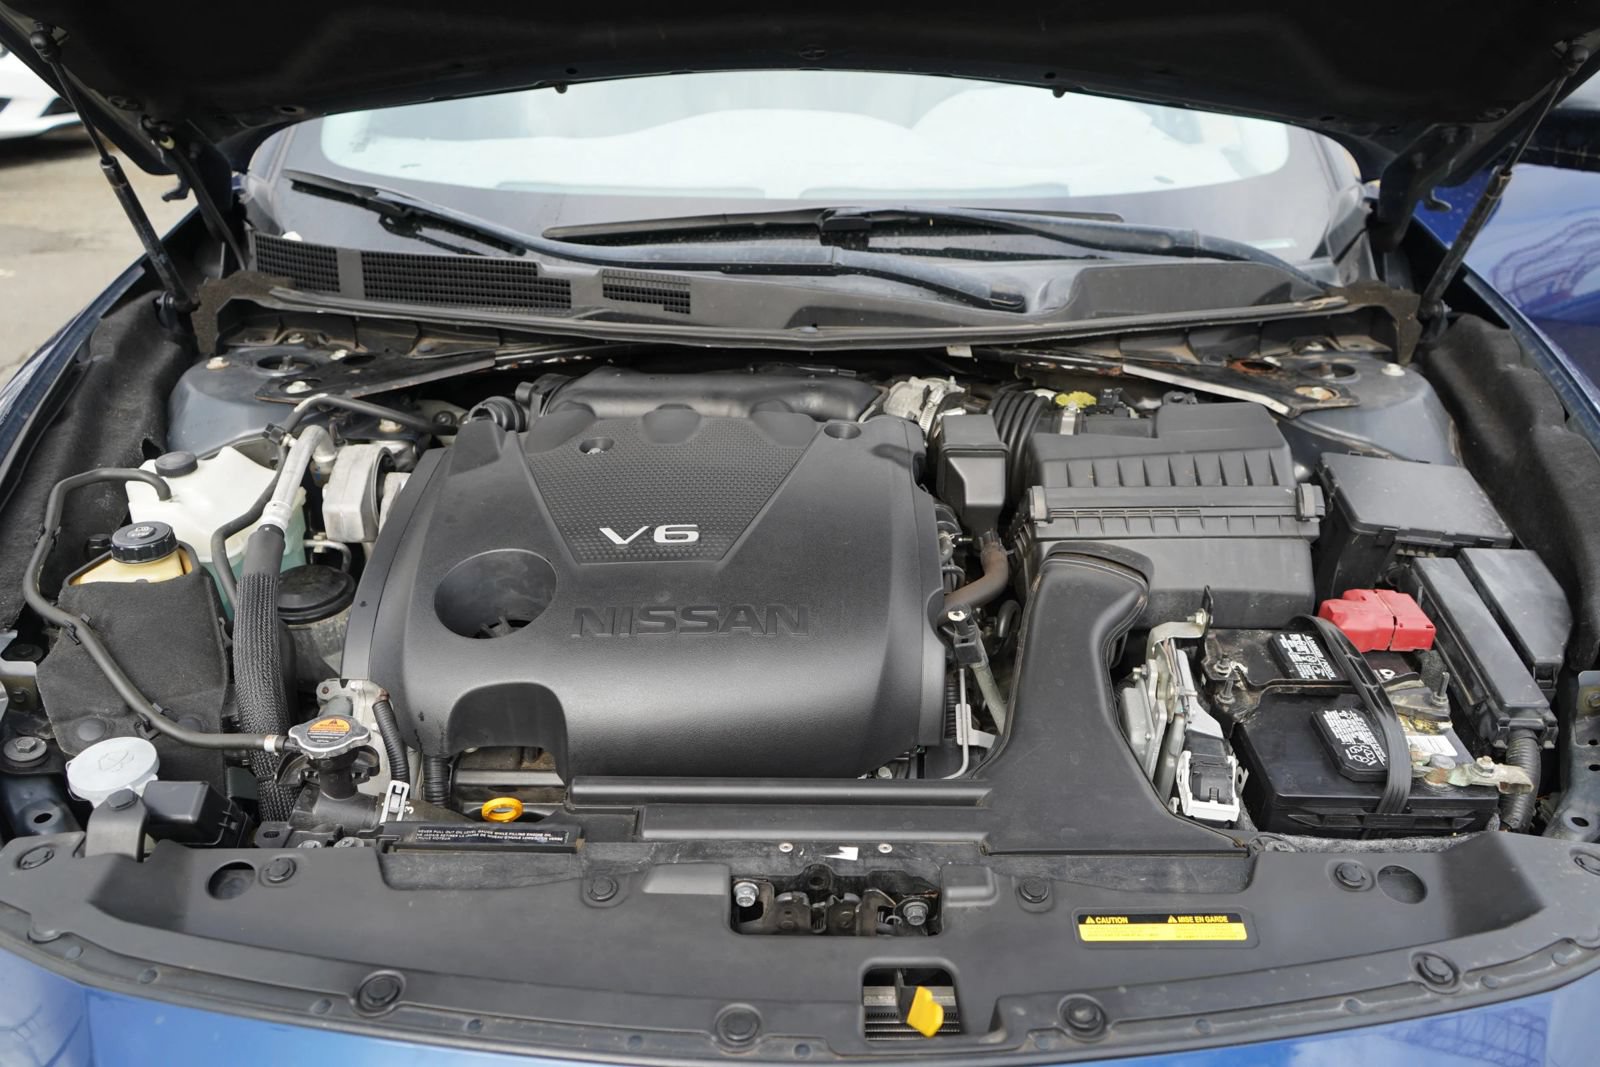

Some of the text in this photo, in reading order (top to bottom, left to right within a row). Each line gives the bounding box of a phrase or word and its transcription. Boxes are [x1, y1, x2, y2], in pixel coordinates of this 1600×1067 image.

[599, 524, 700, 545] V6
[571, 603, 809, 638] NISSAN
[1095, 916, 1129, 924] CAUTION
[1194, 915, 1204, 923] EN
[1204, 915, 1229, 923] GARDE
